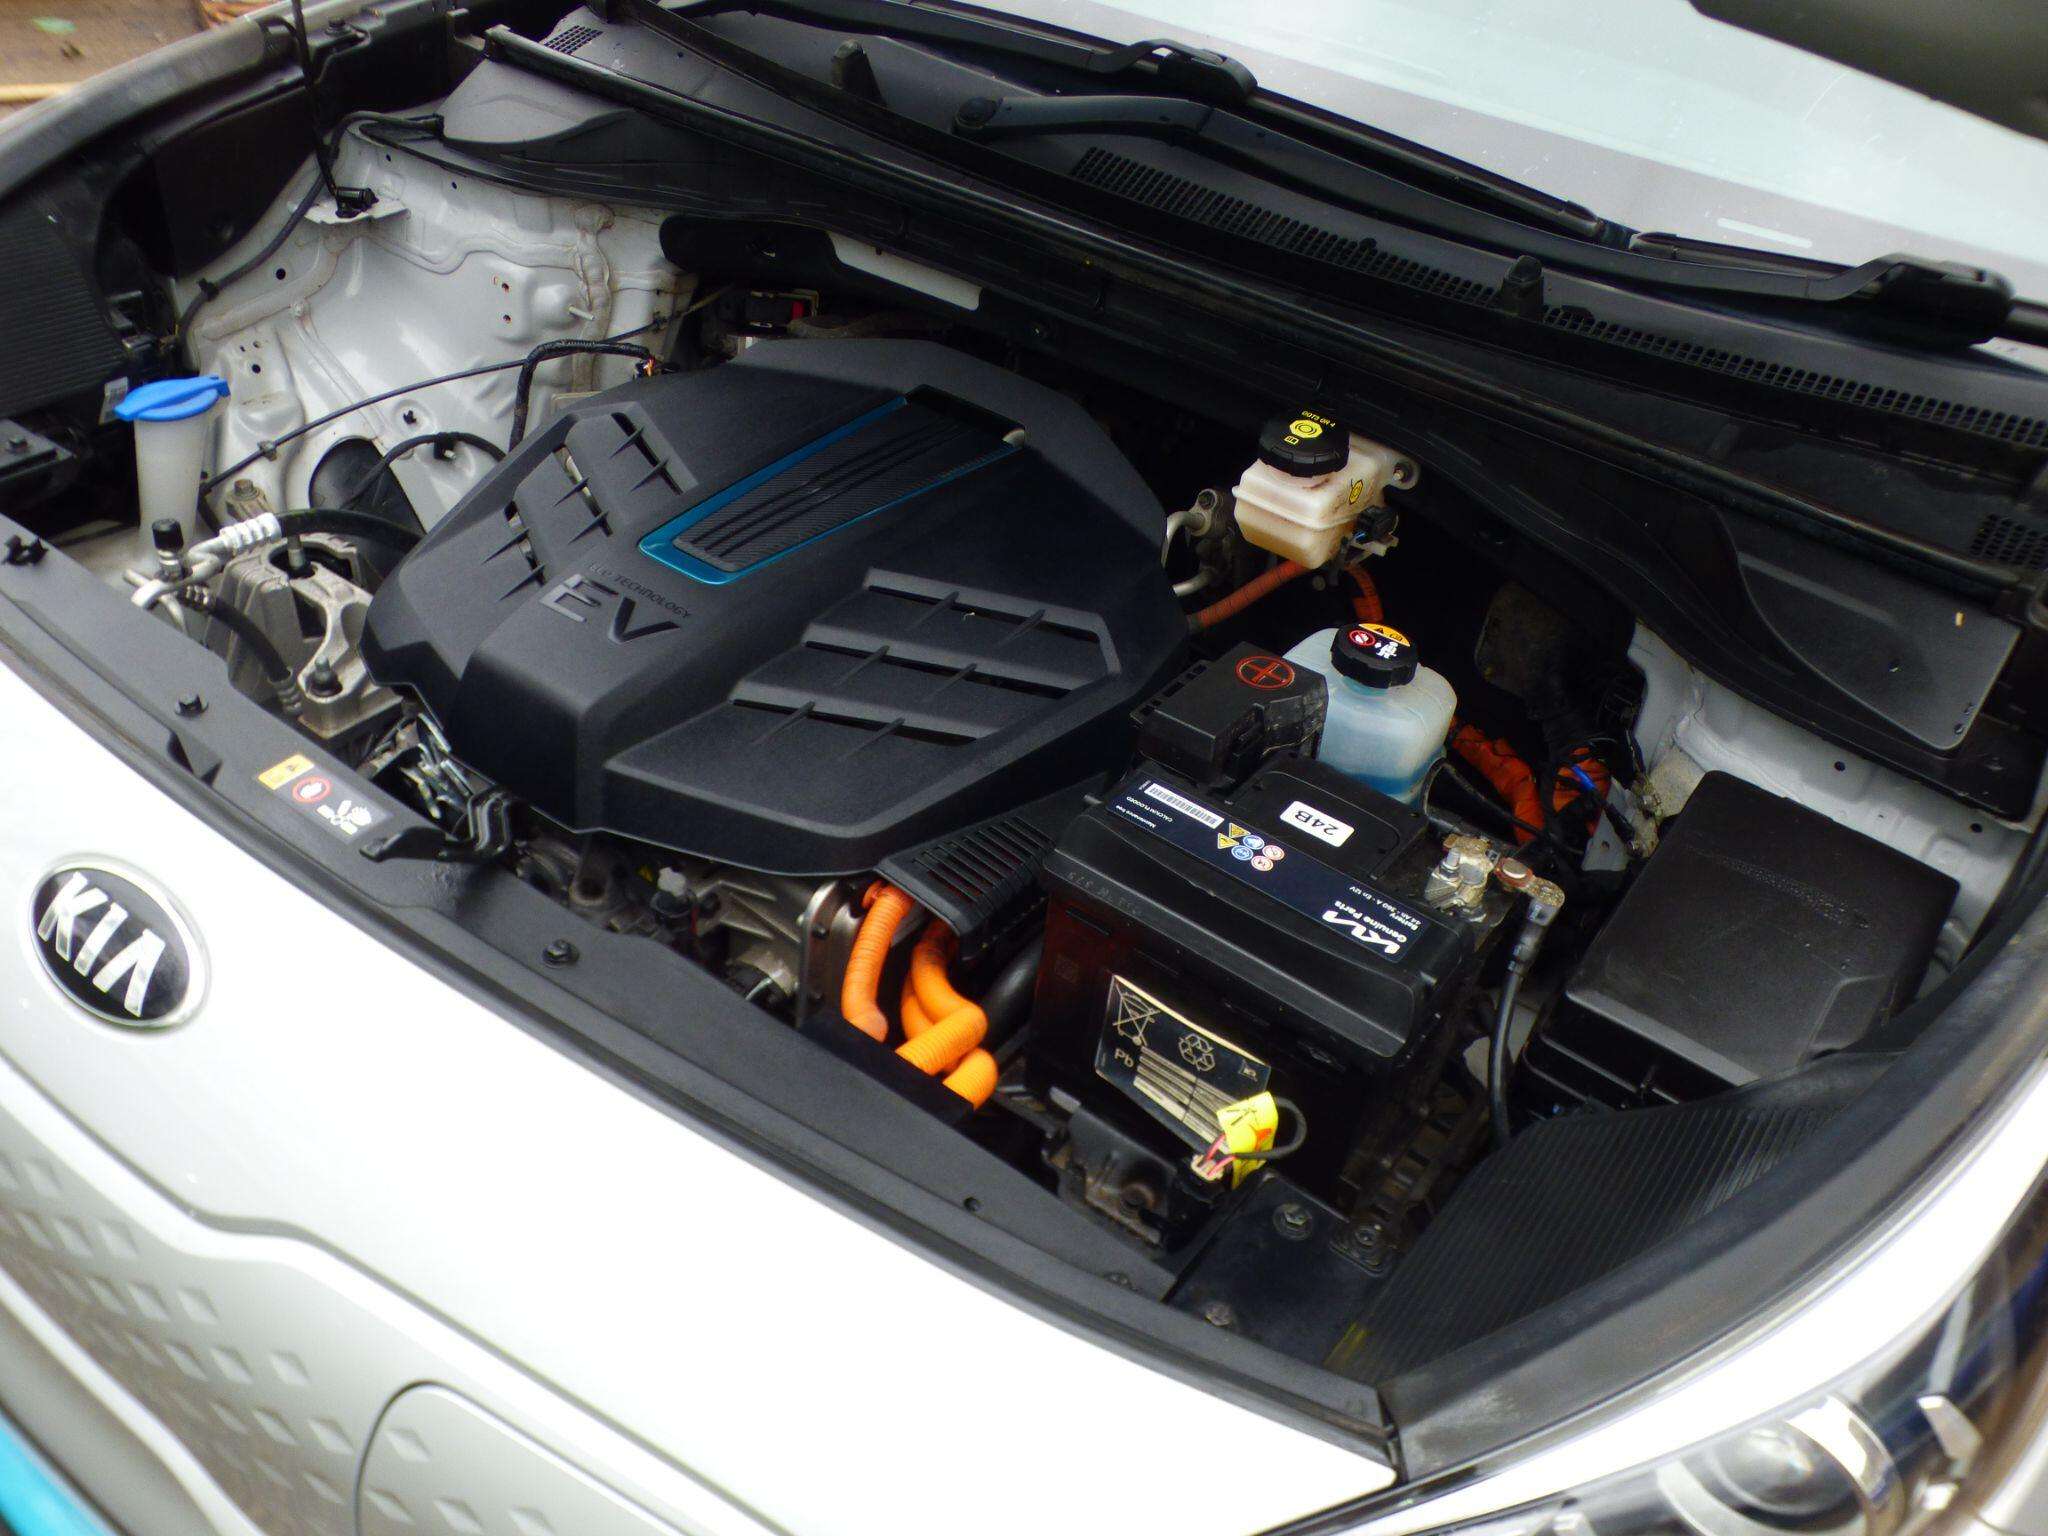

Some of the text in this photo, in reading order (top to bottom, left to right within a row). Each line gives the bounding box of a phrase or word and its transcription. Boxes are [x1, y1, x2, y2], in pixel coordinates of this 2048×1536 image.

[539, 573, 681, 645] EV
[614, 574, 692, 619] TECHNOLOGY
[1294, 810, 1339, 836] 24B
[1334, 900, 1408, 943] Genuine Parts
[1388, 911, 1419, 932] Battery
[37, 871, 166, 1018] KIA
[1114, 1047, 1134, 1068] Pb
